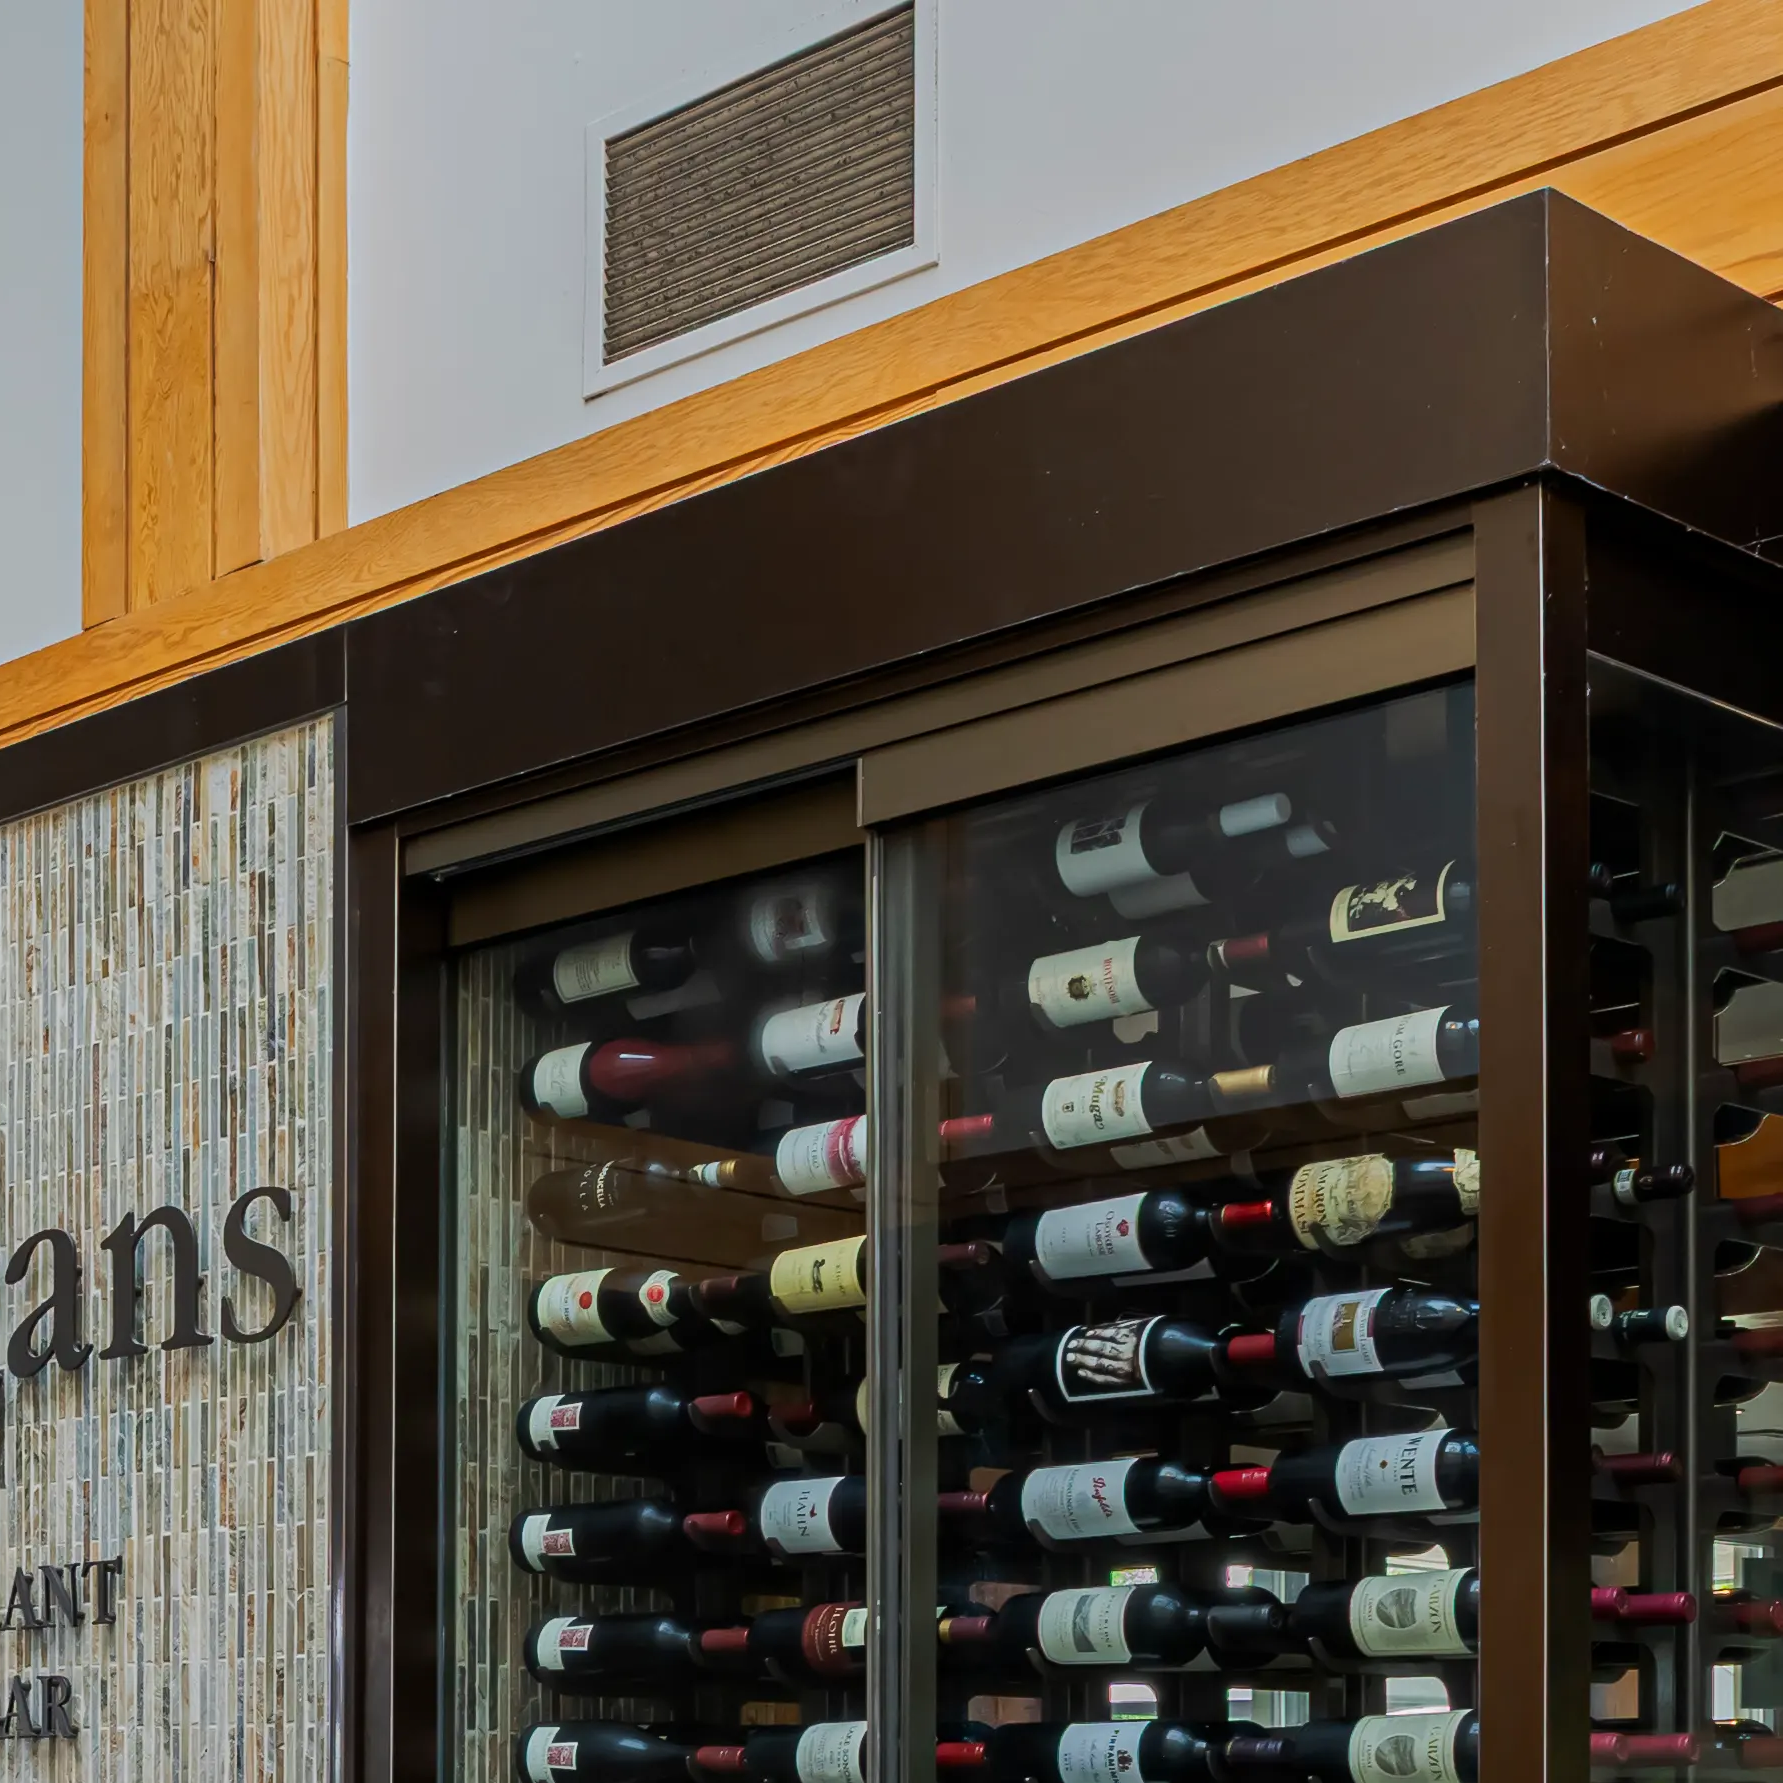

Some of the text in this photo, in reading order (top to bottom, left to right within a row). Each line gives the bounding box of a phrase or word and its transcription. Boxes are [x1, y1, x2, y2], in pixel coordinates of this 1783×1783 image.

[1392, 1039, 1407, 1076] GORE
[1089, 1076, 1108, 1131] Muga
[1400, 1436, 1425, 1495] WENTE
[797, 1490, 811, 1537] HAHN
[843, 1725, 858, 1746] LAKE
